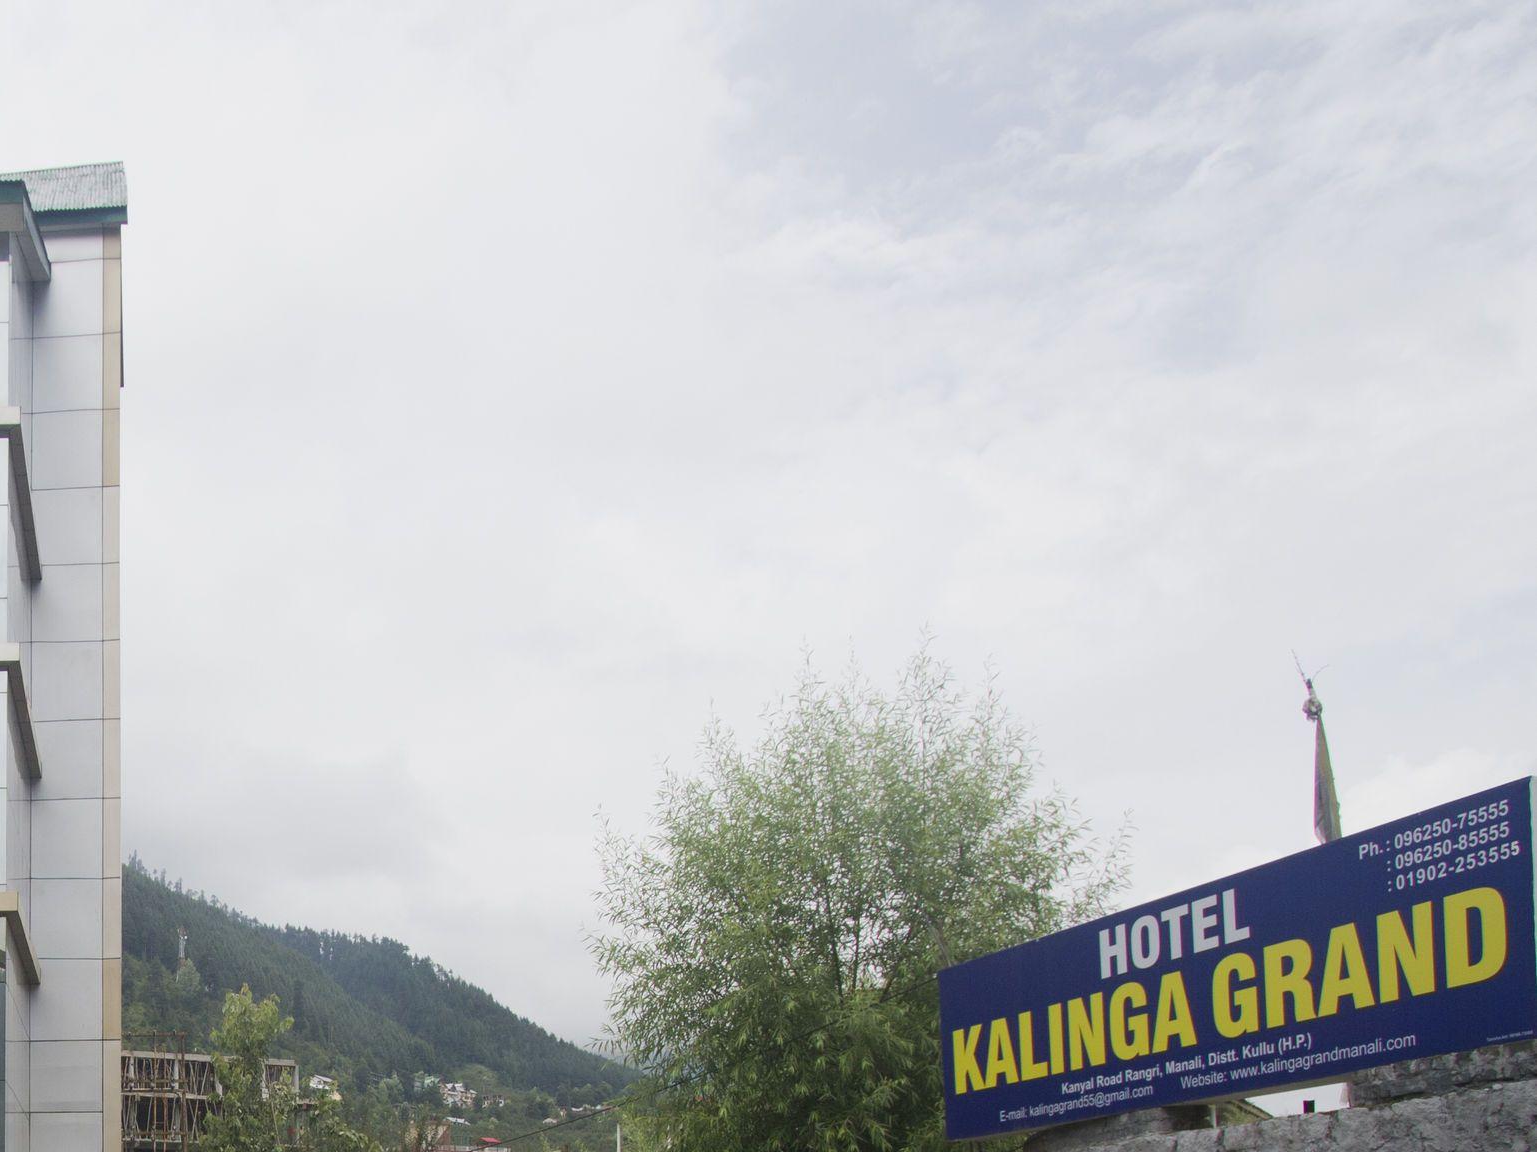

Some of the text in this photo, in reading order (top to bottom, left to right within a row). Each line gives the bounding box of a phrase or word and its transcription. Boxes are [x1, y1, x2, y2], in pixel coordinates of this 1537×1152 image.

[1394, 799, 1509, 850] 096250-75555
[1395, 821, 1510, 870] 096250-85555
[1395, 840, 1521, 891] 01902-253555
[1098, 888, 1251, 980] HOTEL
[951, 886, 1508, 1096] KALINGA GRAND
[999, 1033, 1416, 1122] E-mail: kalingagrand55@gmail.com Website: www.kalingagrandmanali.com
[1061, 1032, 1312, 1096] Kanyal Road Rangri, Manali, Distt. Kullu (H.P.)
